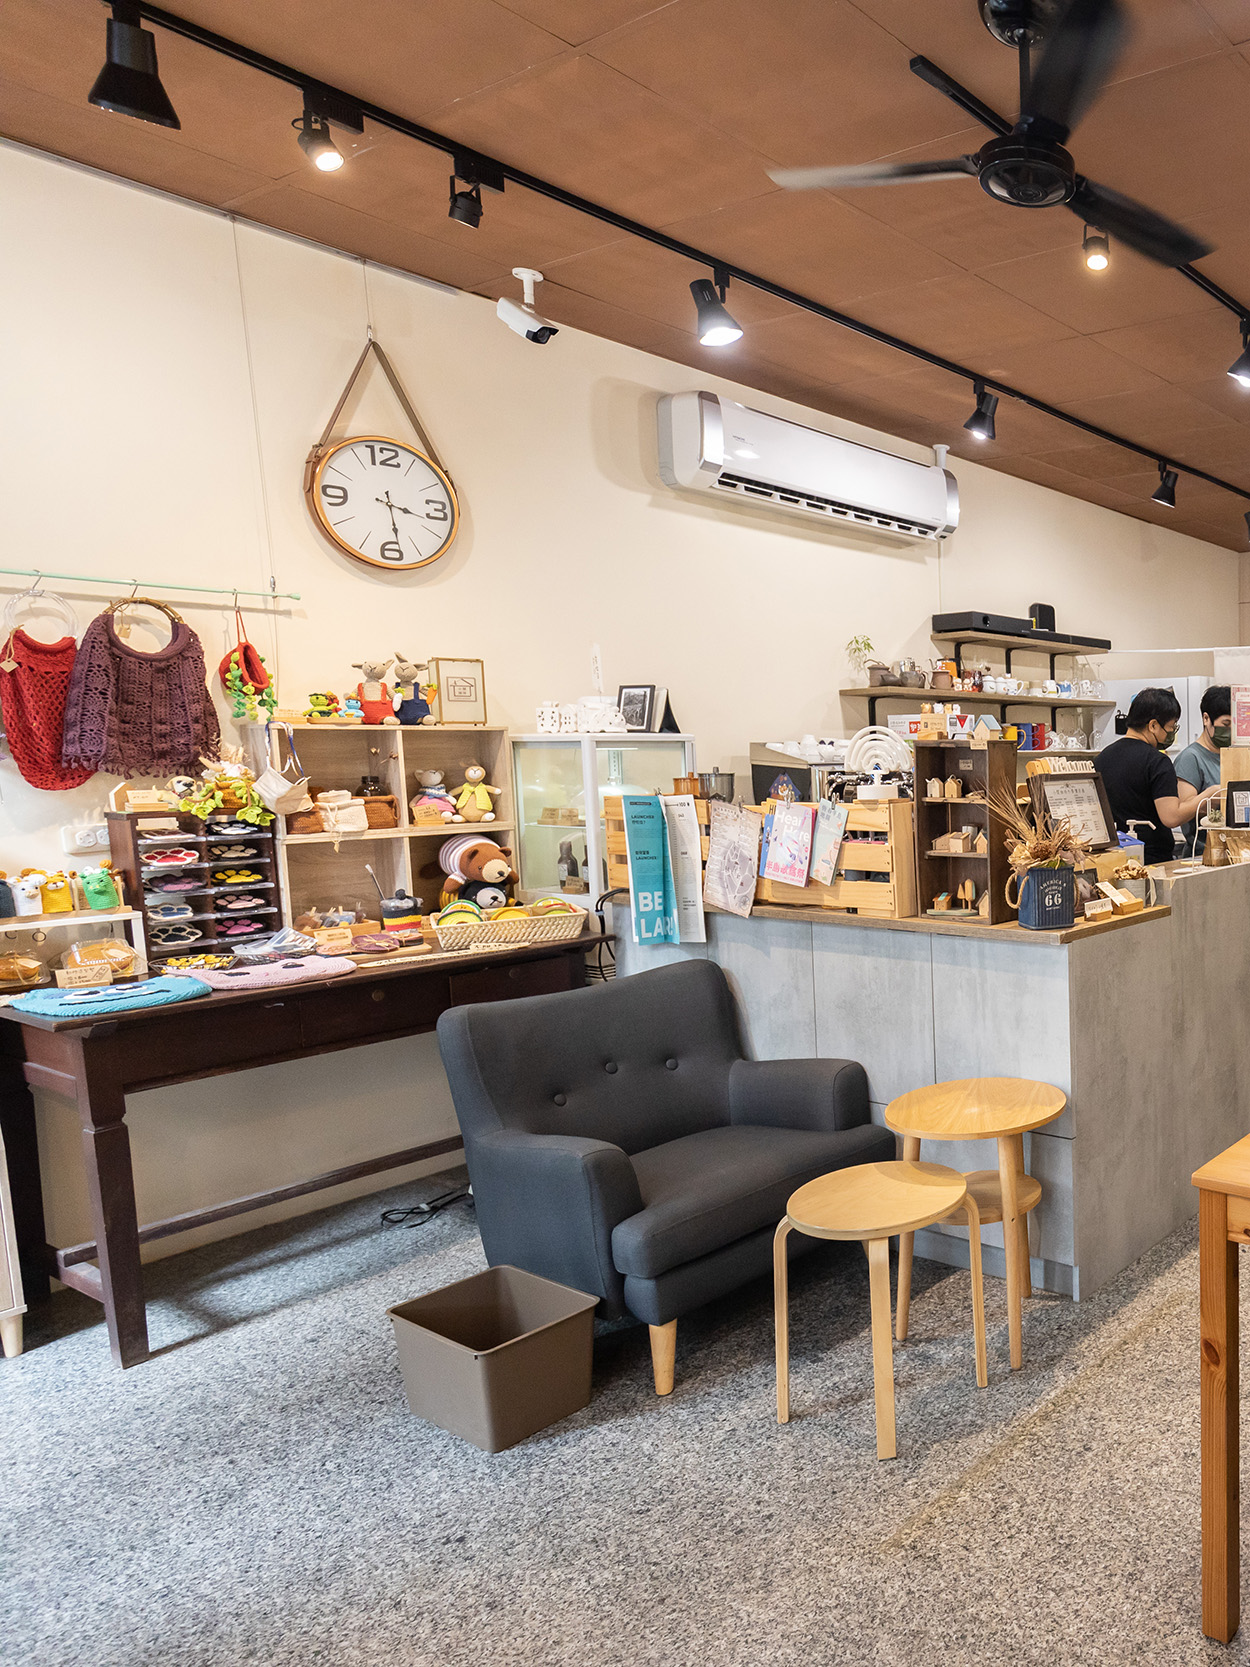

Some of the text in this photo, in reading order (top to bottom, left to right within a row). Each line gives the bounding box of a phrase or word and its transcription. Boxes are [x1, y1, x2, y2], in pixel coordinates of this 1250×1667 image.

[365, 445, 401, 469] 12
[321, 484, 349, 507] 9
[424, 499, 448, 522] 3
[380, 541, 404, 561] 6
[1047, 756, 1096, 773] Welcome
[775, 809, 802, 827] Hear
[638, 891, 663, 912] BE
[1044, 893, 1062, 907] 66
